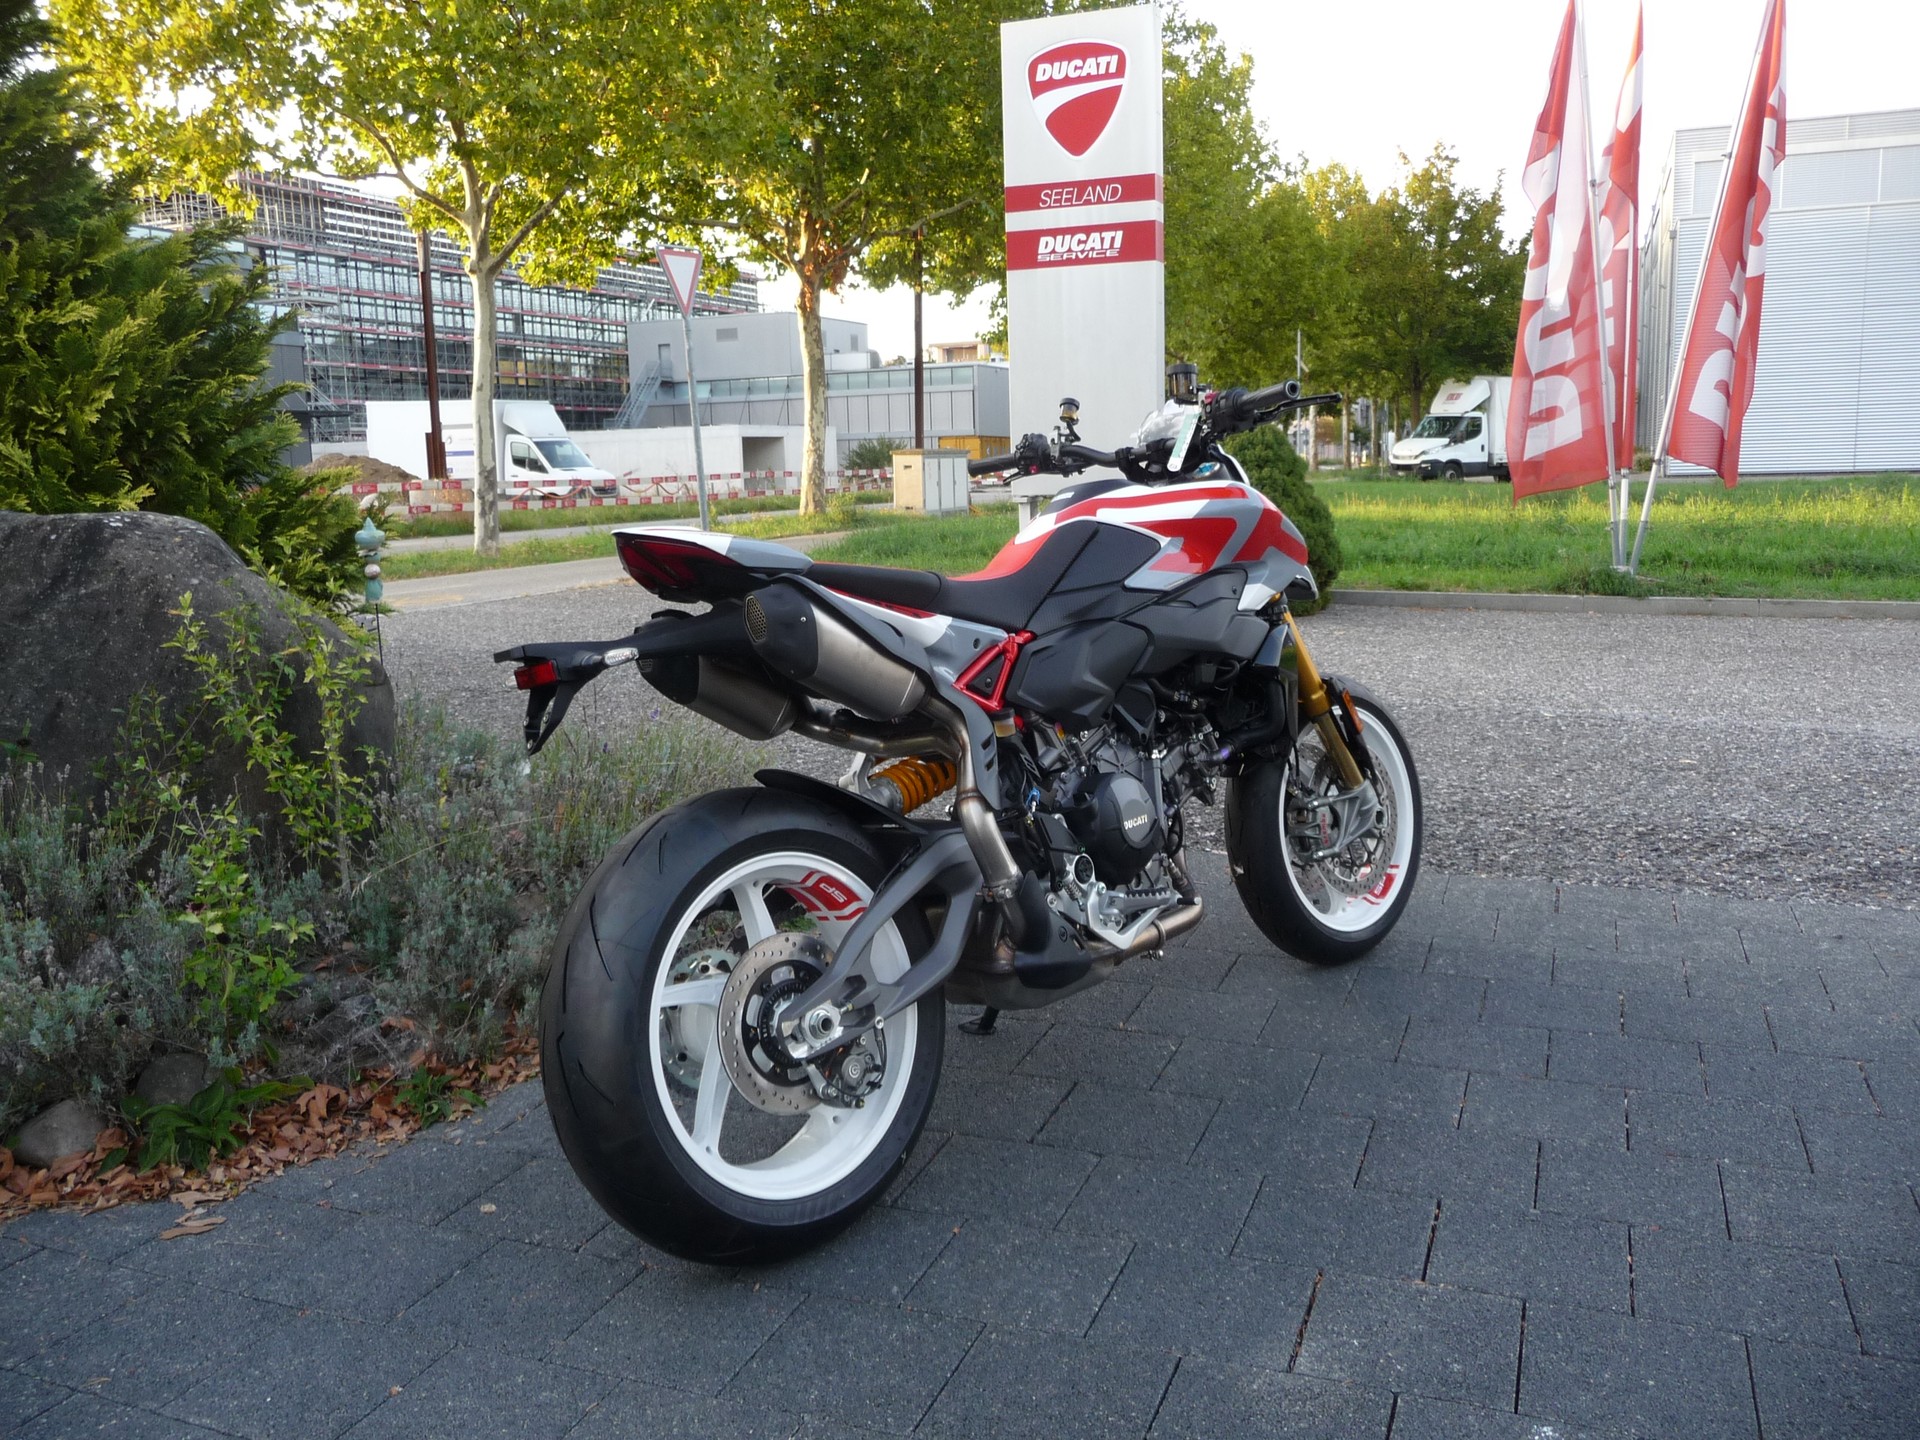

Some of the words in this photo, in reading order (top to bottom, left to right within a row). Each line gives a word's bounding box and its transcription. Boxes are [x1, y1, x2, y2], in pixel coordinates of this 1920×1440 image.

[1035, 55, 1119, 82] DUCATI
[1039, 183, 1122, 208] SEELAND
[1037, 230, 1124, 254] DUCATI
[1037, 249, 1120, 262] SERVICE
[1123, 814, 1148, 830] DUCATI
